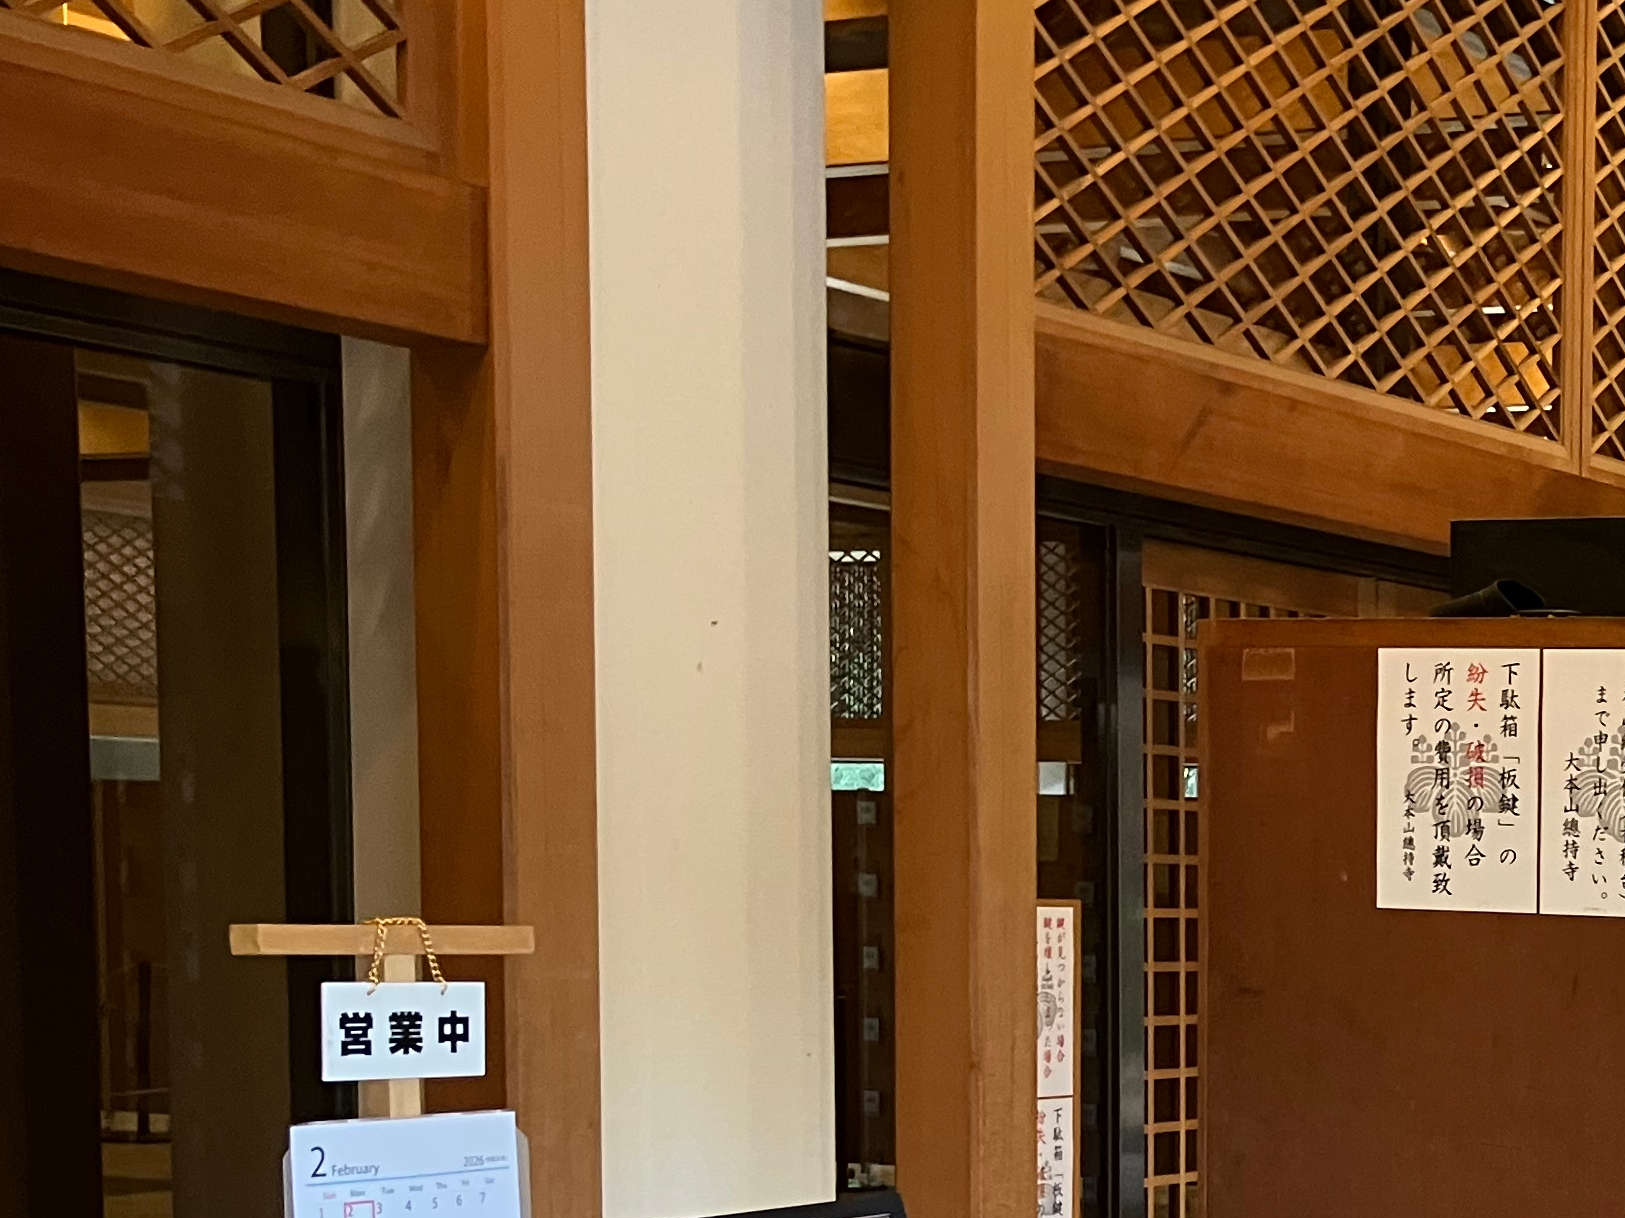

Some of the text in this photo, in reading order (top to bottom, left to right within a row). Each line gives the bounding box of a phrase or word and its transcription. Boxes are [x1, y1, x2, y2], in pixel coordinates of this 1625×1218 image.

[1400, 663, 1421, 748] します。
[1464, 663, 1488, 867] 紛失・破損の場合
[1498, 663, 1521, 865] 下駄箱「板鍵」の
[1432, 662, 1454, 896] 所定の費用を頂戴致
[1592, 686, 1608, 900] まで申し出ください。
[339, 1010, 470, 1056] 営業中
[311, 1146, 380, 1181] 2 February
[319, 1192, 486, 1218] 1 2 3 4 5 6 7
